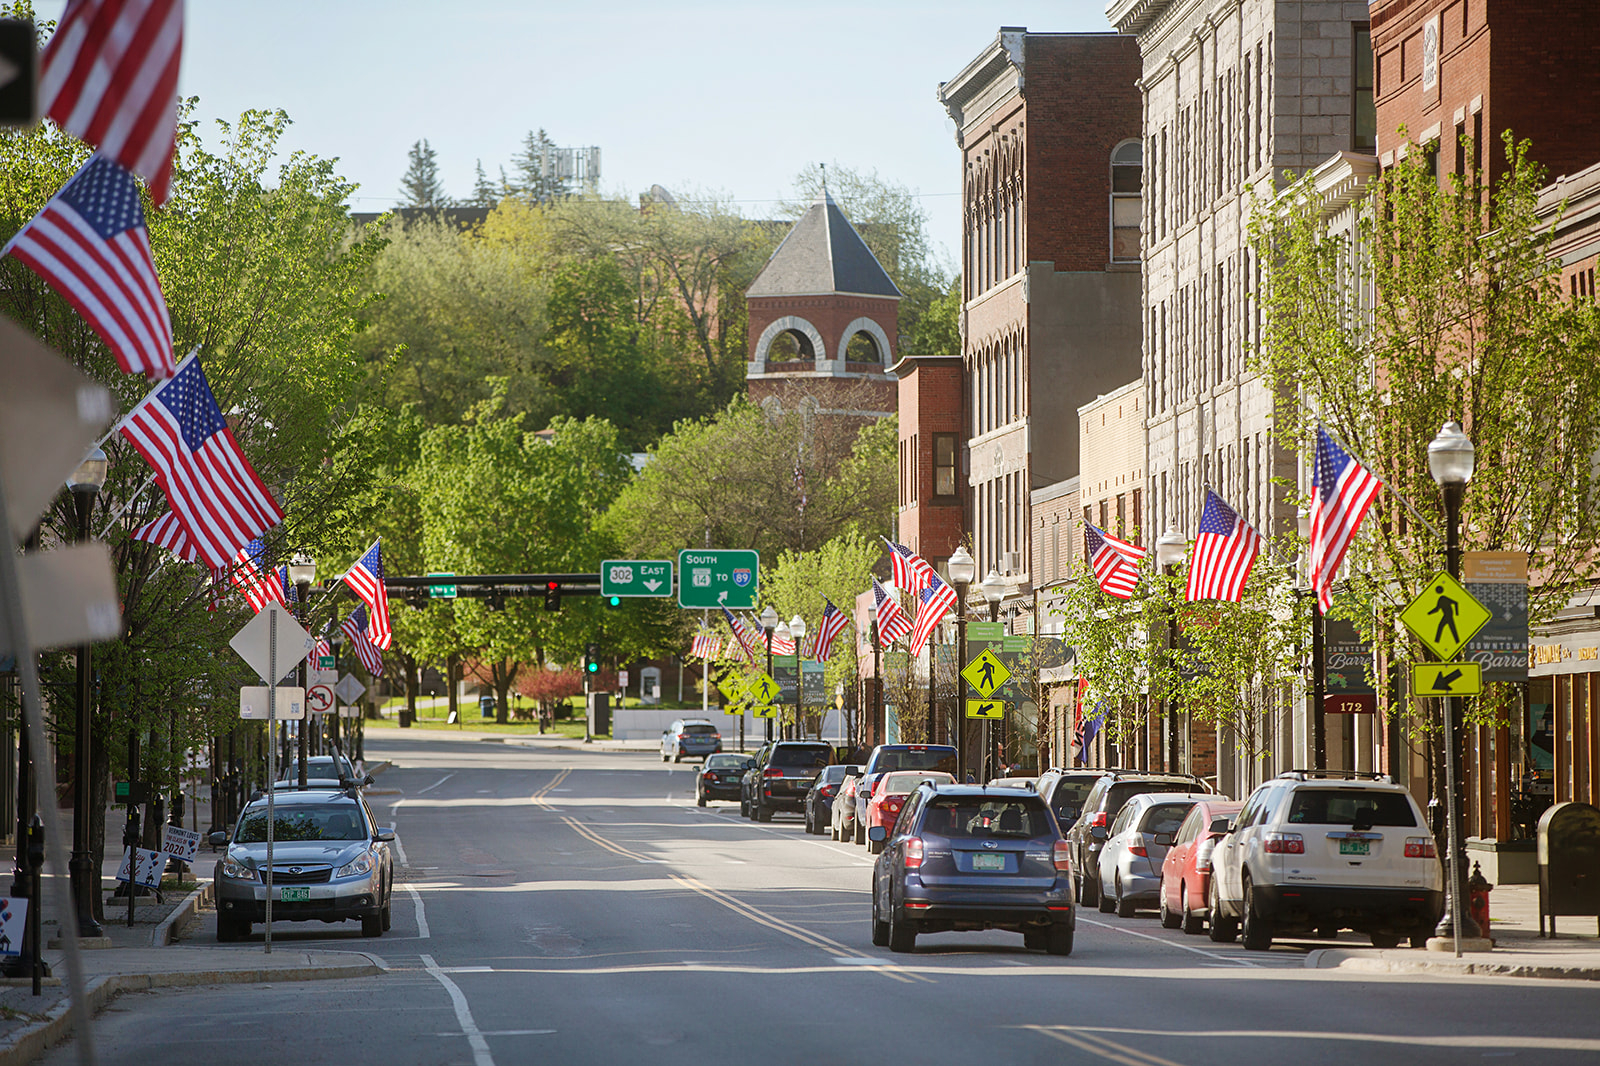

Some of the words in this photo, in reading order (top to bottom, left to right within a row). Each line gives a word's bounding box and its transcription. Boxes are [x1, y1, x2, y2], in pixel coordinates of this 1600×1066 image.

[686, 555, 718, 565] SOUTH
[611, 569, 632, 581] 302
[640, 566, 665, 575] EAST
[696, 575, 707, 585] 14
[716, 573, 728, 582] TO
[736, 573, 749, 583] 89
[1469, 642, 1527, 650] DOWNTOWN
[1326, 653, 1372, 670] Barre
[1470, 651, 1527, 672] Barre
[1340, 702, 1363, 712] 172
[186, 831, 200, 841] LOVES
[163, 841, 185, 856] 2020
